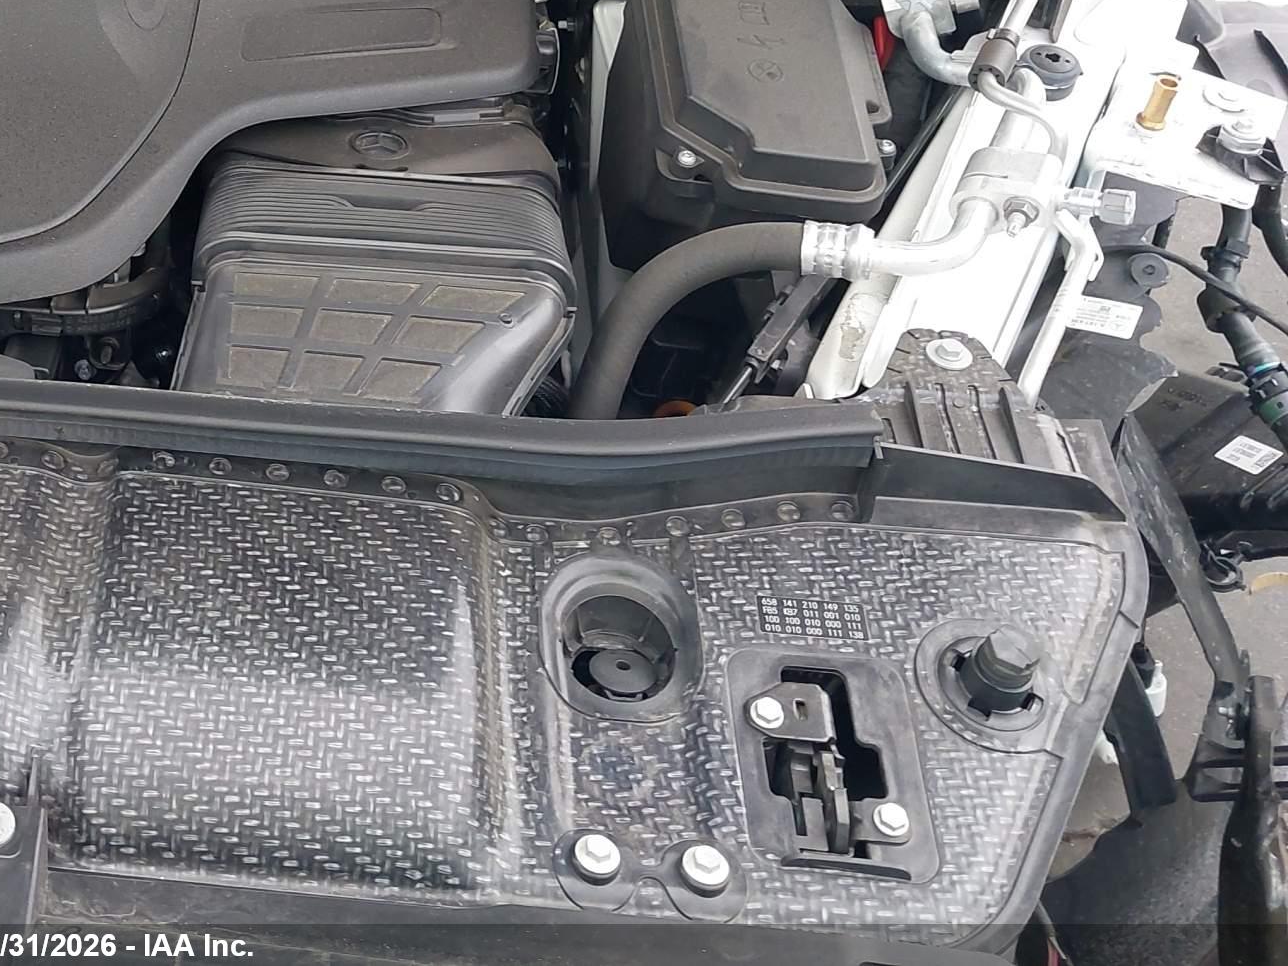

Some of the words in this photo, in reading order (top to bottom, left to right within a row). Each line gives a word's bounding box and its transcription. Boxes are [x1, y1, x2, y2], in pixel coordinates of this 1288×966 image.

[802, 601, 818, 609] 210
[844, 613, 860, 621] 010
[805, 618, 821, 626] 010
[825, 620, 841, 628] 000
[765, 624, 781, 632] 010
[786, 625, 801, 633] 010
[806, 627, 822, 635] 000
[828, 629, 842, 637] 111
